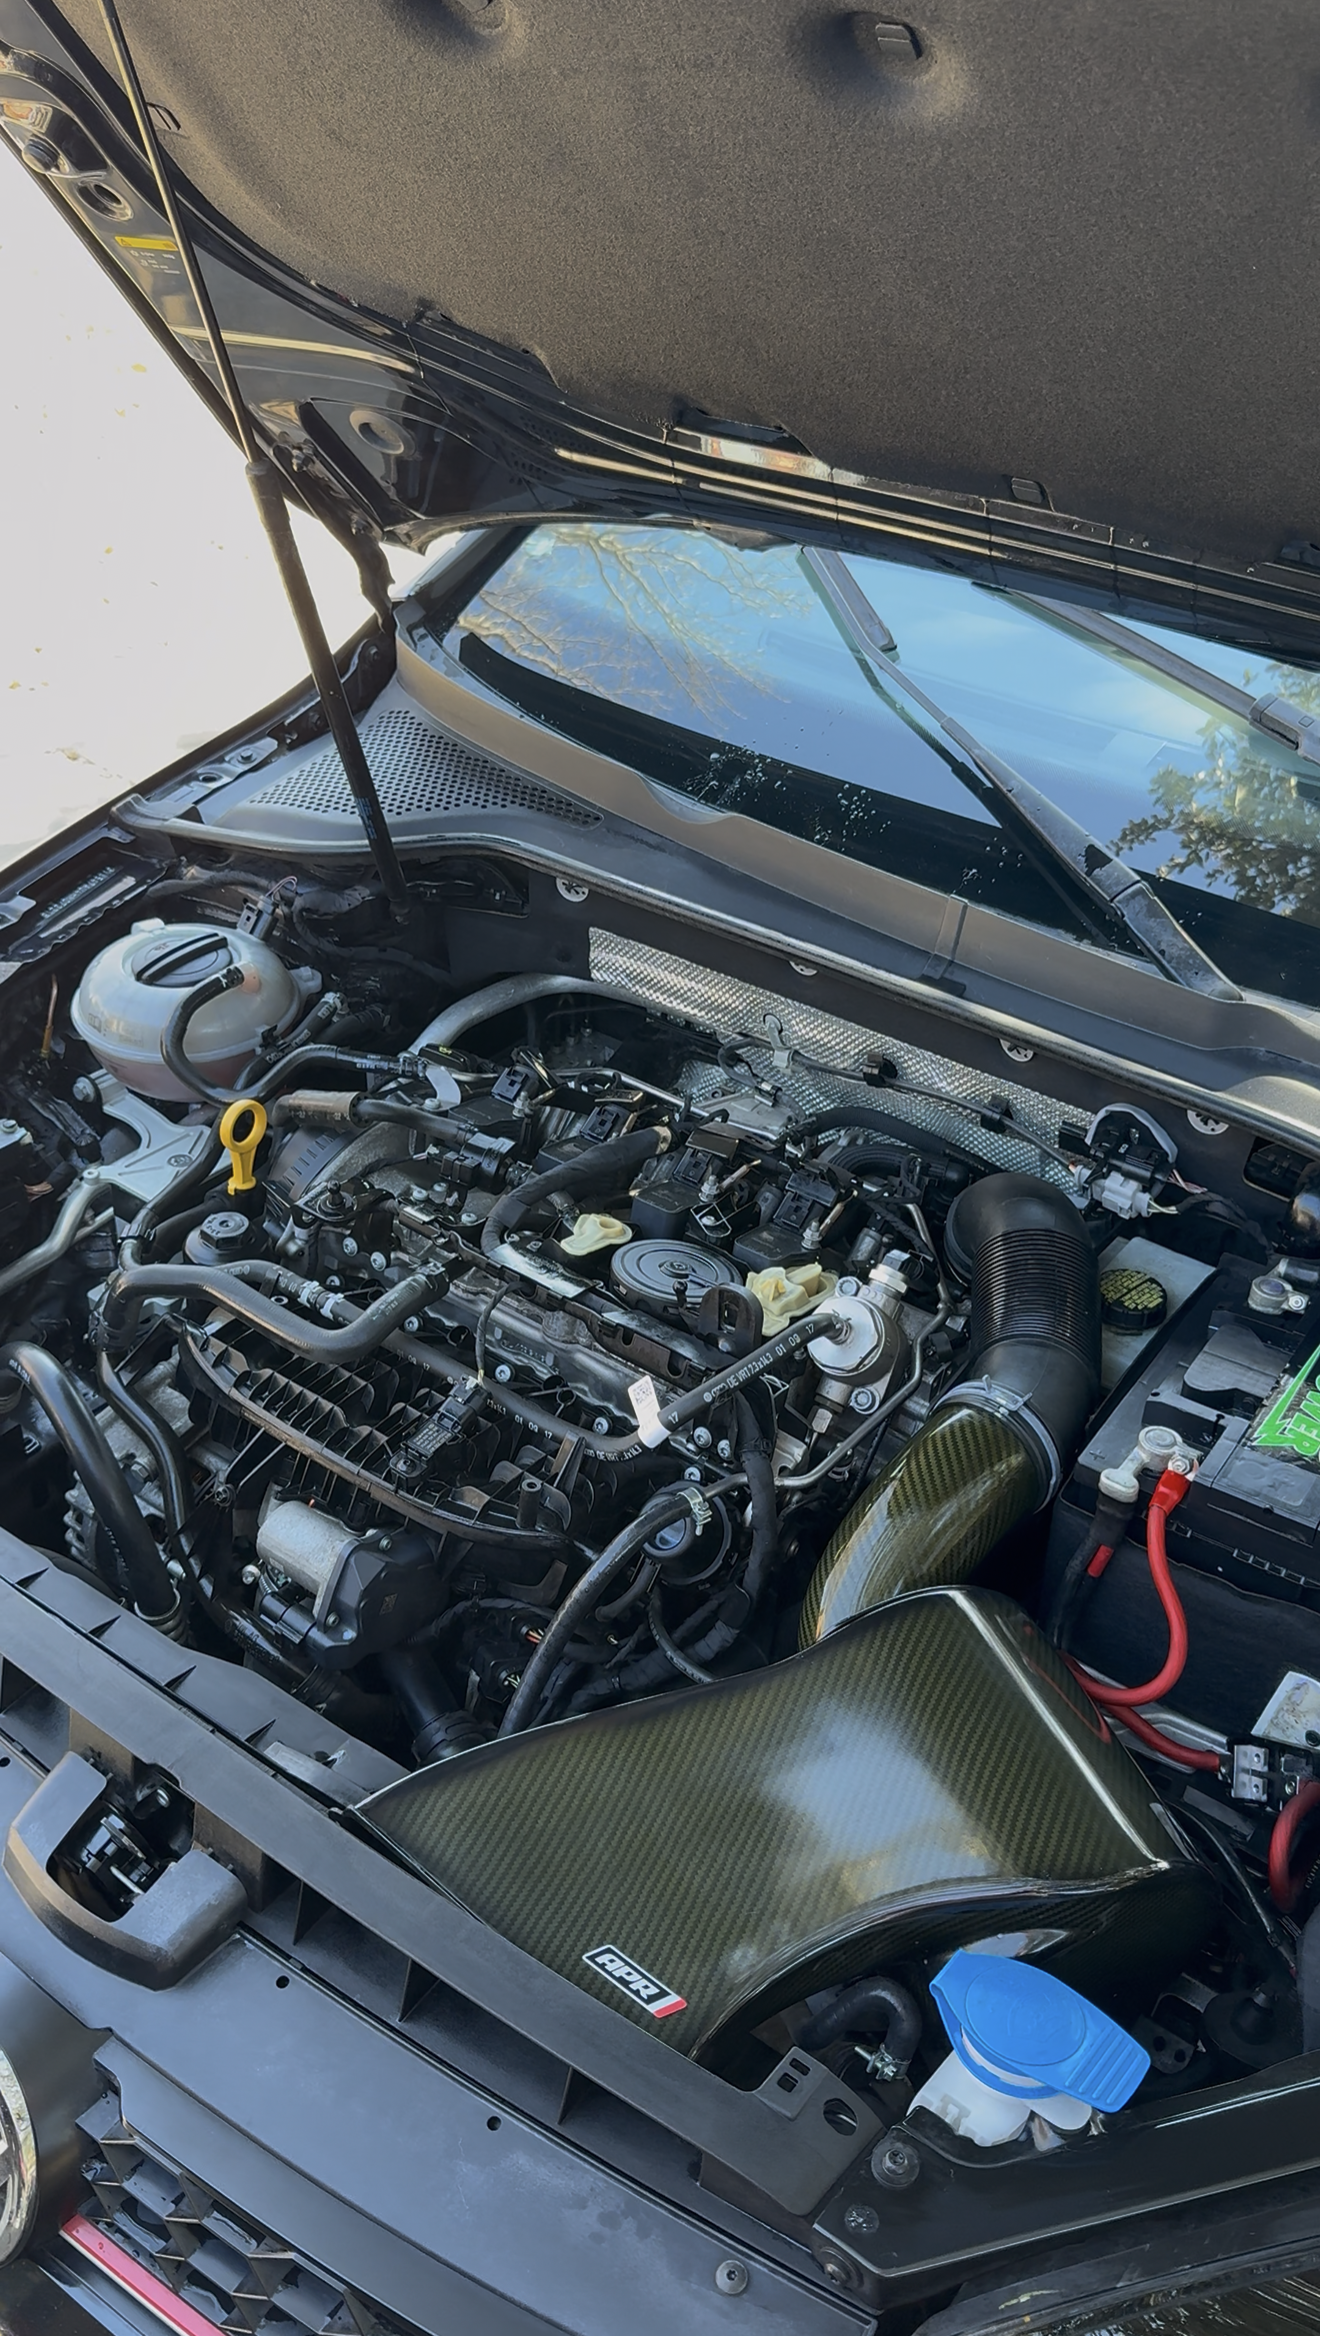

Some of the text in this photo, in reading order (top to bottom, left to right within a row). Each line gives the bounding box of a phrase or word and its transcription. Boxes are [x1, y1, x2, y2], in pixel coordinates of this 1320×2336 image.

[774, 1343, 787, 1357] 01
[788, 1333, 801, 1347] 09
[805, 1323, 815, 1335] 17
[667, 1411, 679, 1424] 17
[594, 1953, 661, 2000] APR
